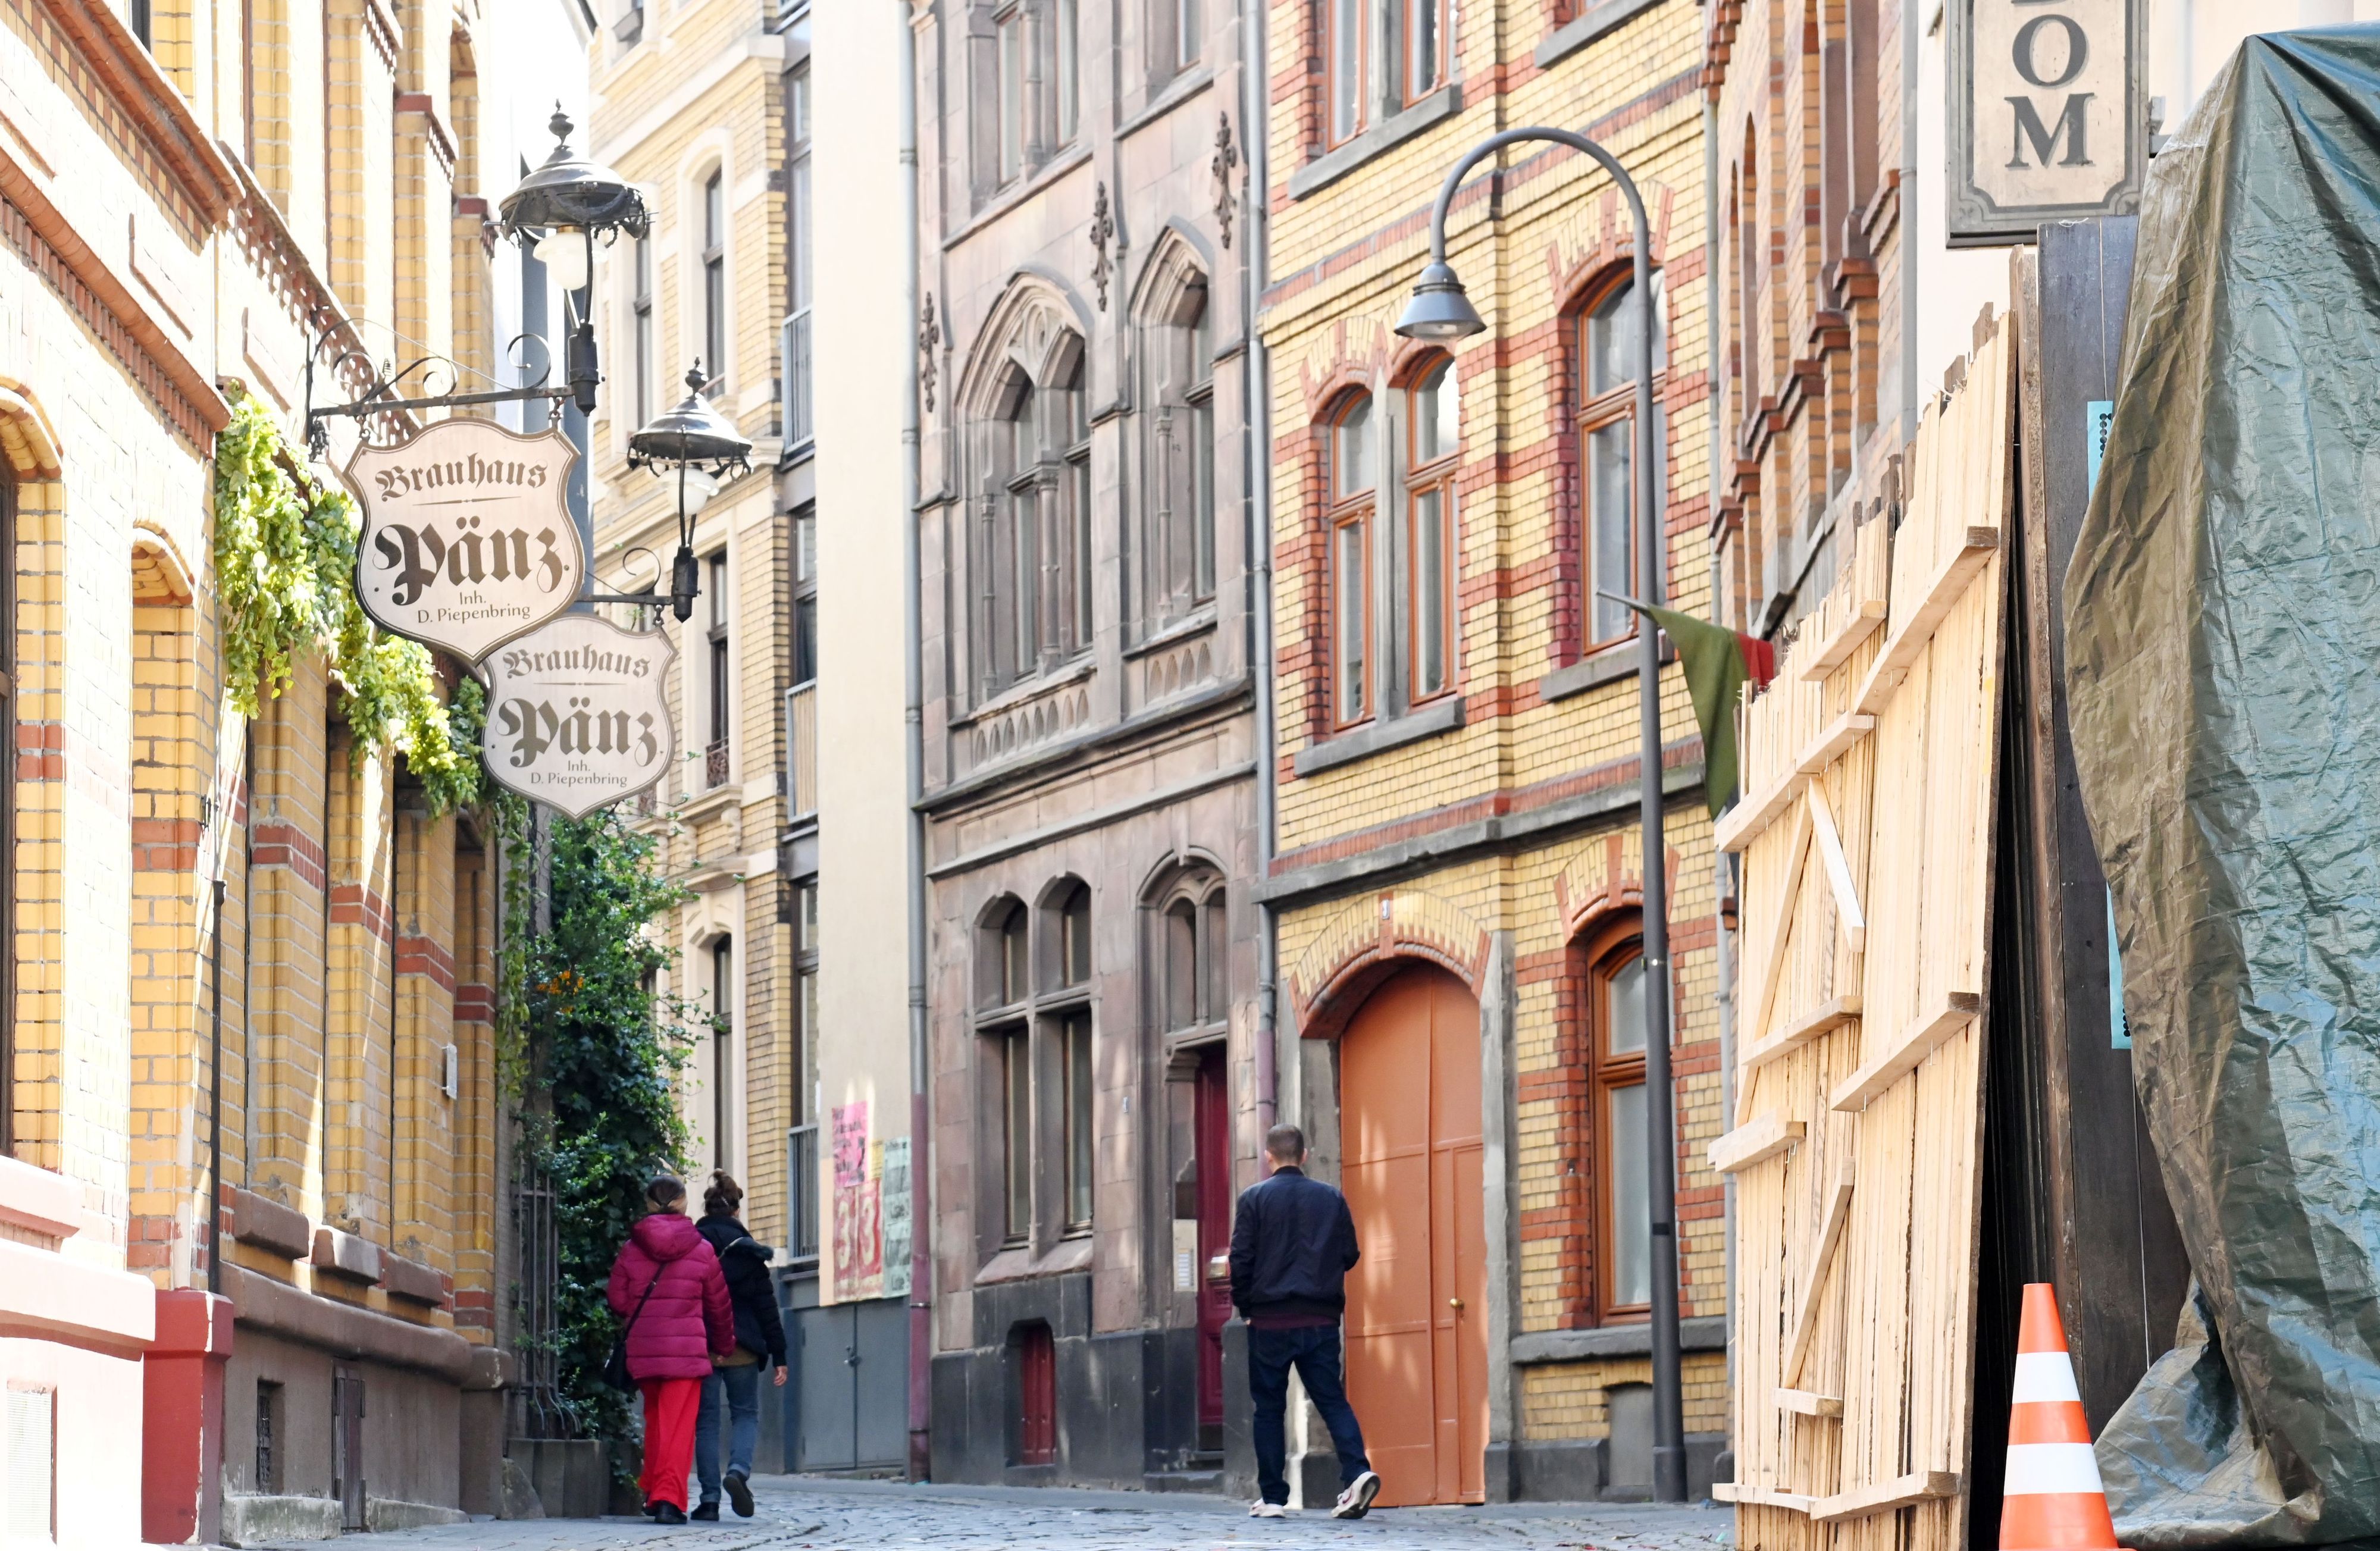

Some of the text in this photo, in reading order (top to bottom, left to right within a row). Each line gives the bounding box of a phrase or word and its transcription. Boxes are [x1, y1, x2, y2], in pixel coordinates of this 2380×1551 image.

[2004, 0, 2098, 169] OM
[375, 452, 548, 502] Brauhaus
[372, 515, 563, 606] Pänz
[418, 604, 531, 624] D. Piepenbring
[459, 590, 487, 605] Inh.
[503, 644, 651, 679] Brauhaus
[496, 697, 657, 767] Pänz
[530, 772, 628, 788] D. Piepenbring
[568, 760, 591, 772] Inh.
